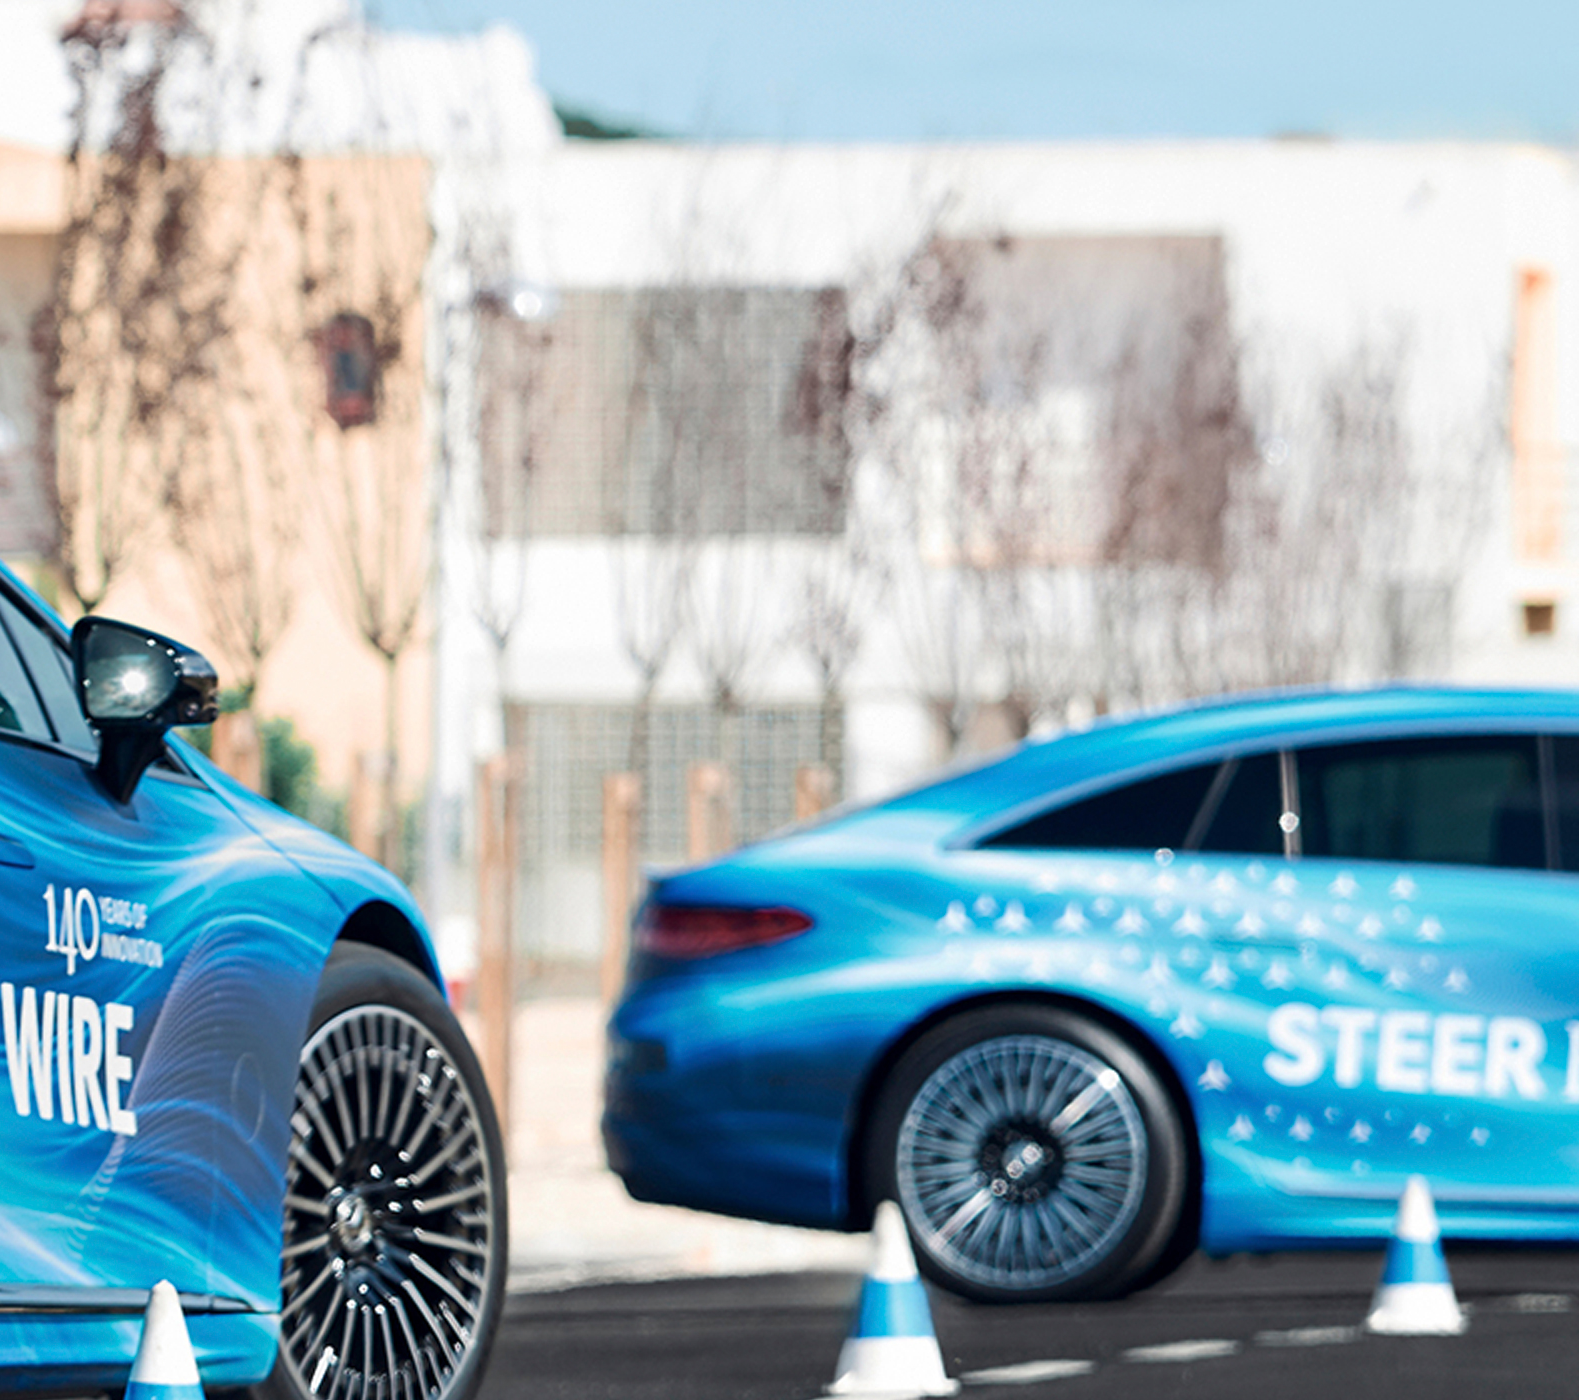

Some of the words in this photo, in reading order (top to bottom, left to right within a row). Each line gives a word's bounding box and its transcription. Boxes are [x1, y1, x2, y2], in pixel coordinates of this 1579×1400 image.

[42, 882, 101, 977] 140
[0, 982, 137, 1137] WIRE
[1263, 1001, 1547, 1102] STEER
